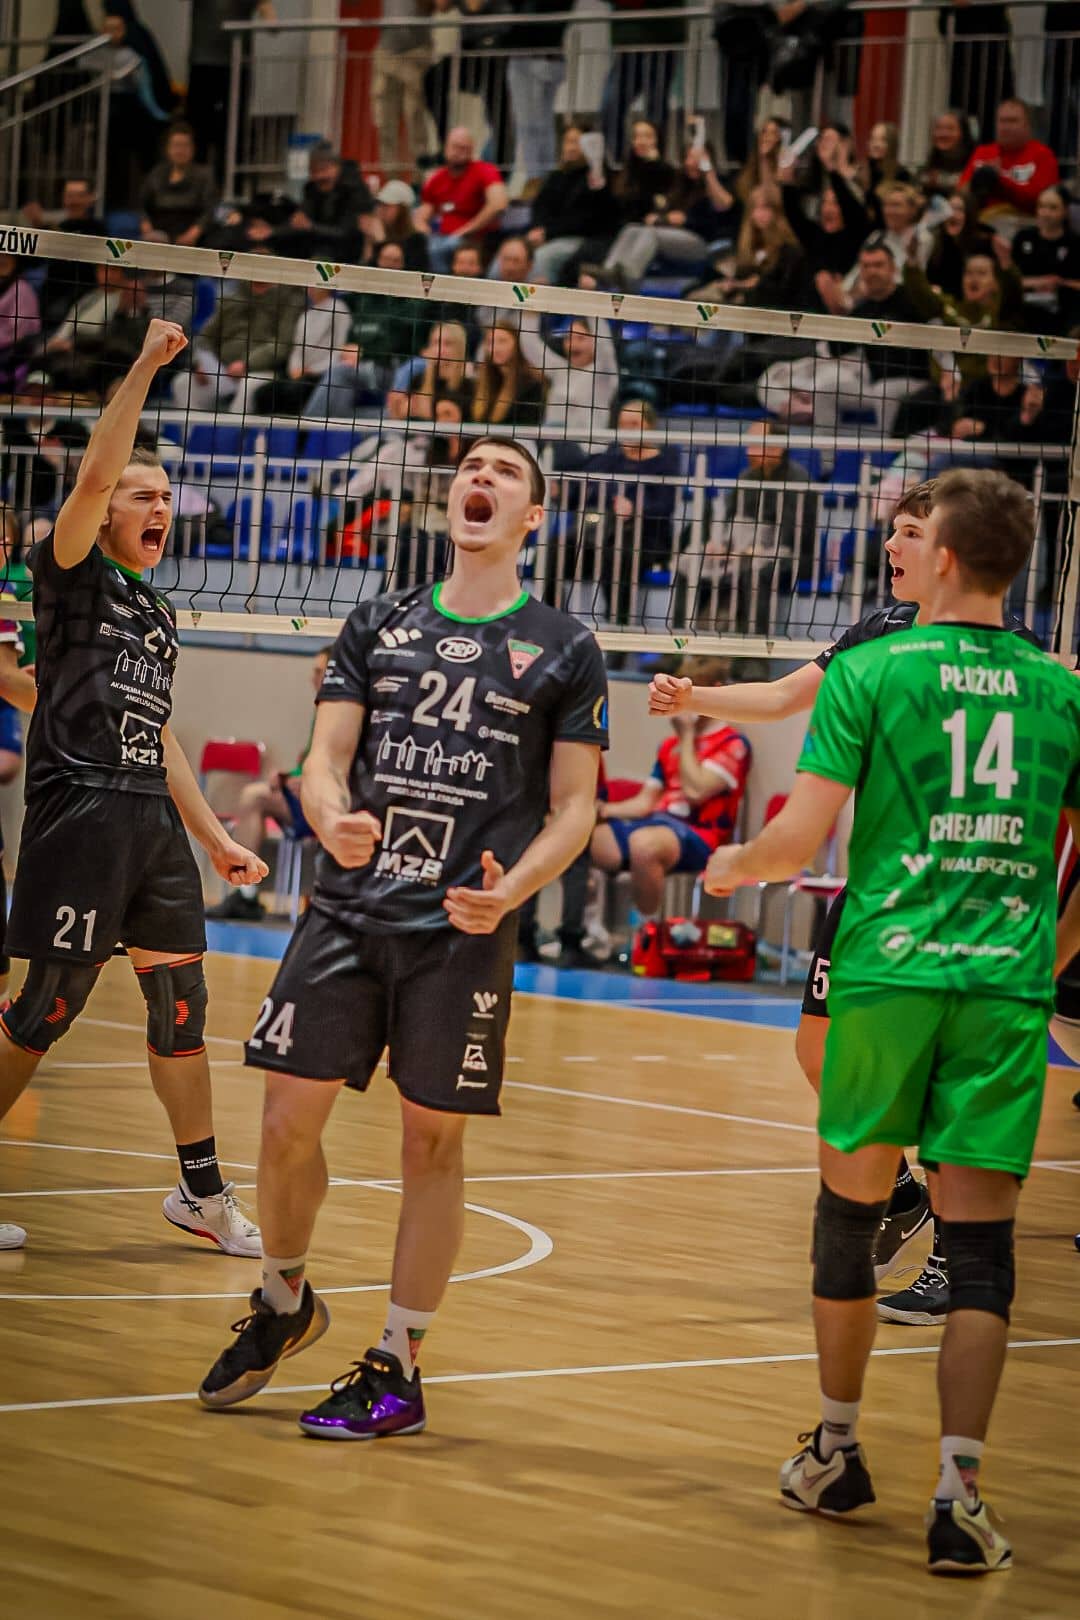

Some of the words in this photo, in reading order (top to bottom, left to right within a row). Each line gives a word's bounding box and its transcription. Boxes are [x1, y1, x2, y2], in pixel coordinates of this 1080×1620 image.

[411, 670, 477, 732] 24
[942, 709, 1019, 800] 14
[928, 813, 1024, 845] CHEŁMIEC
[376, 851, 444, 881] MZB
[940, 856, 1039, 879] WAŁBRZYCH
[52, 905, 98, 953] 21
[812, 957, 832, 1000] 5
[248, 996, 296, 1056] 24
